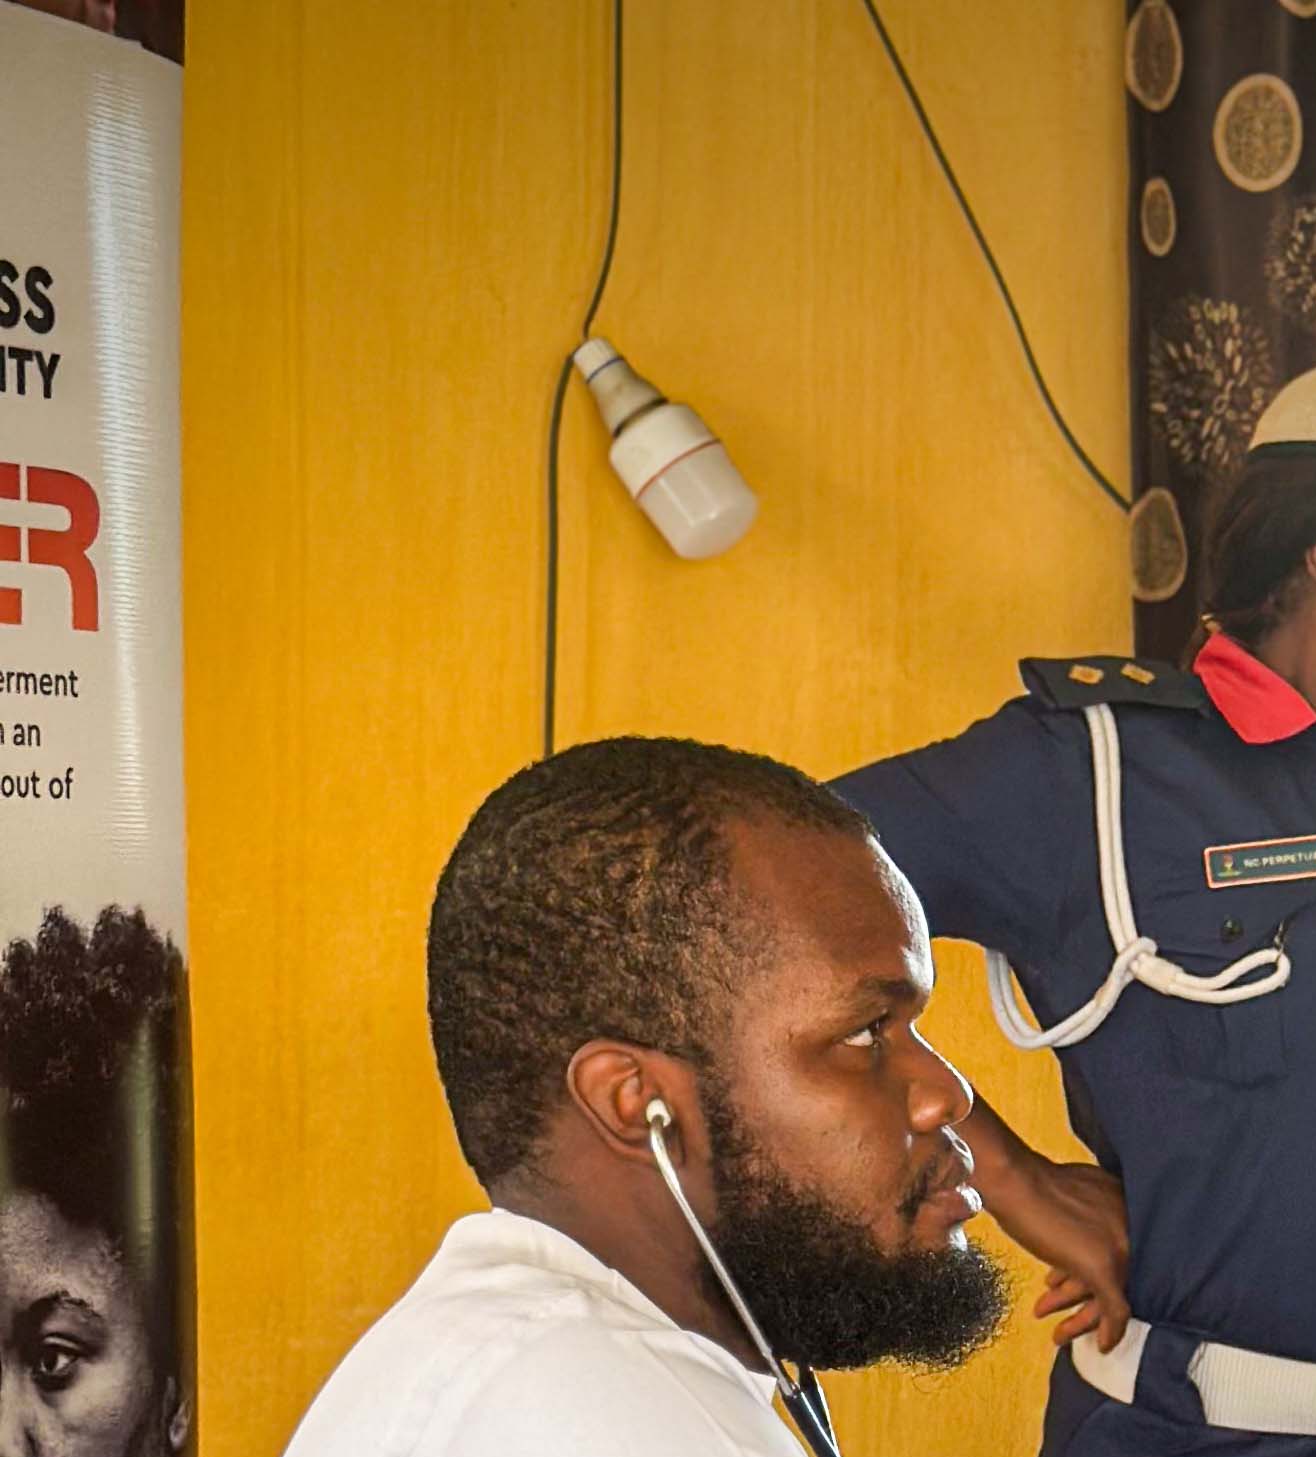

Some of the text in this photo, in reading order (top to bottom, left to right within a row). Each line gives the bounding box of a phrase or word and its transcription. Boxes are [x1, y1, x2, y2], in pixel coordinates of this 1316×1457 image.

[13, 723, 41, 746] an
[1, 767, 74, 799] out of
